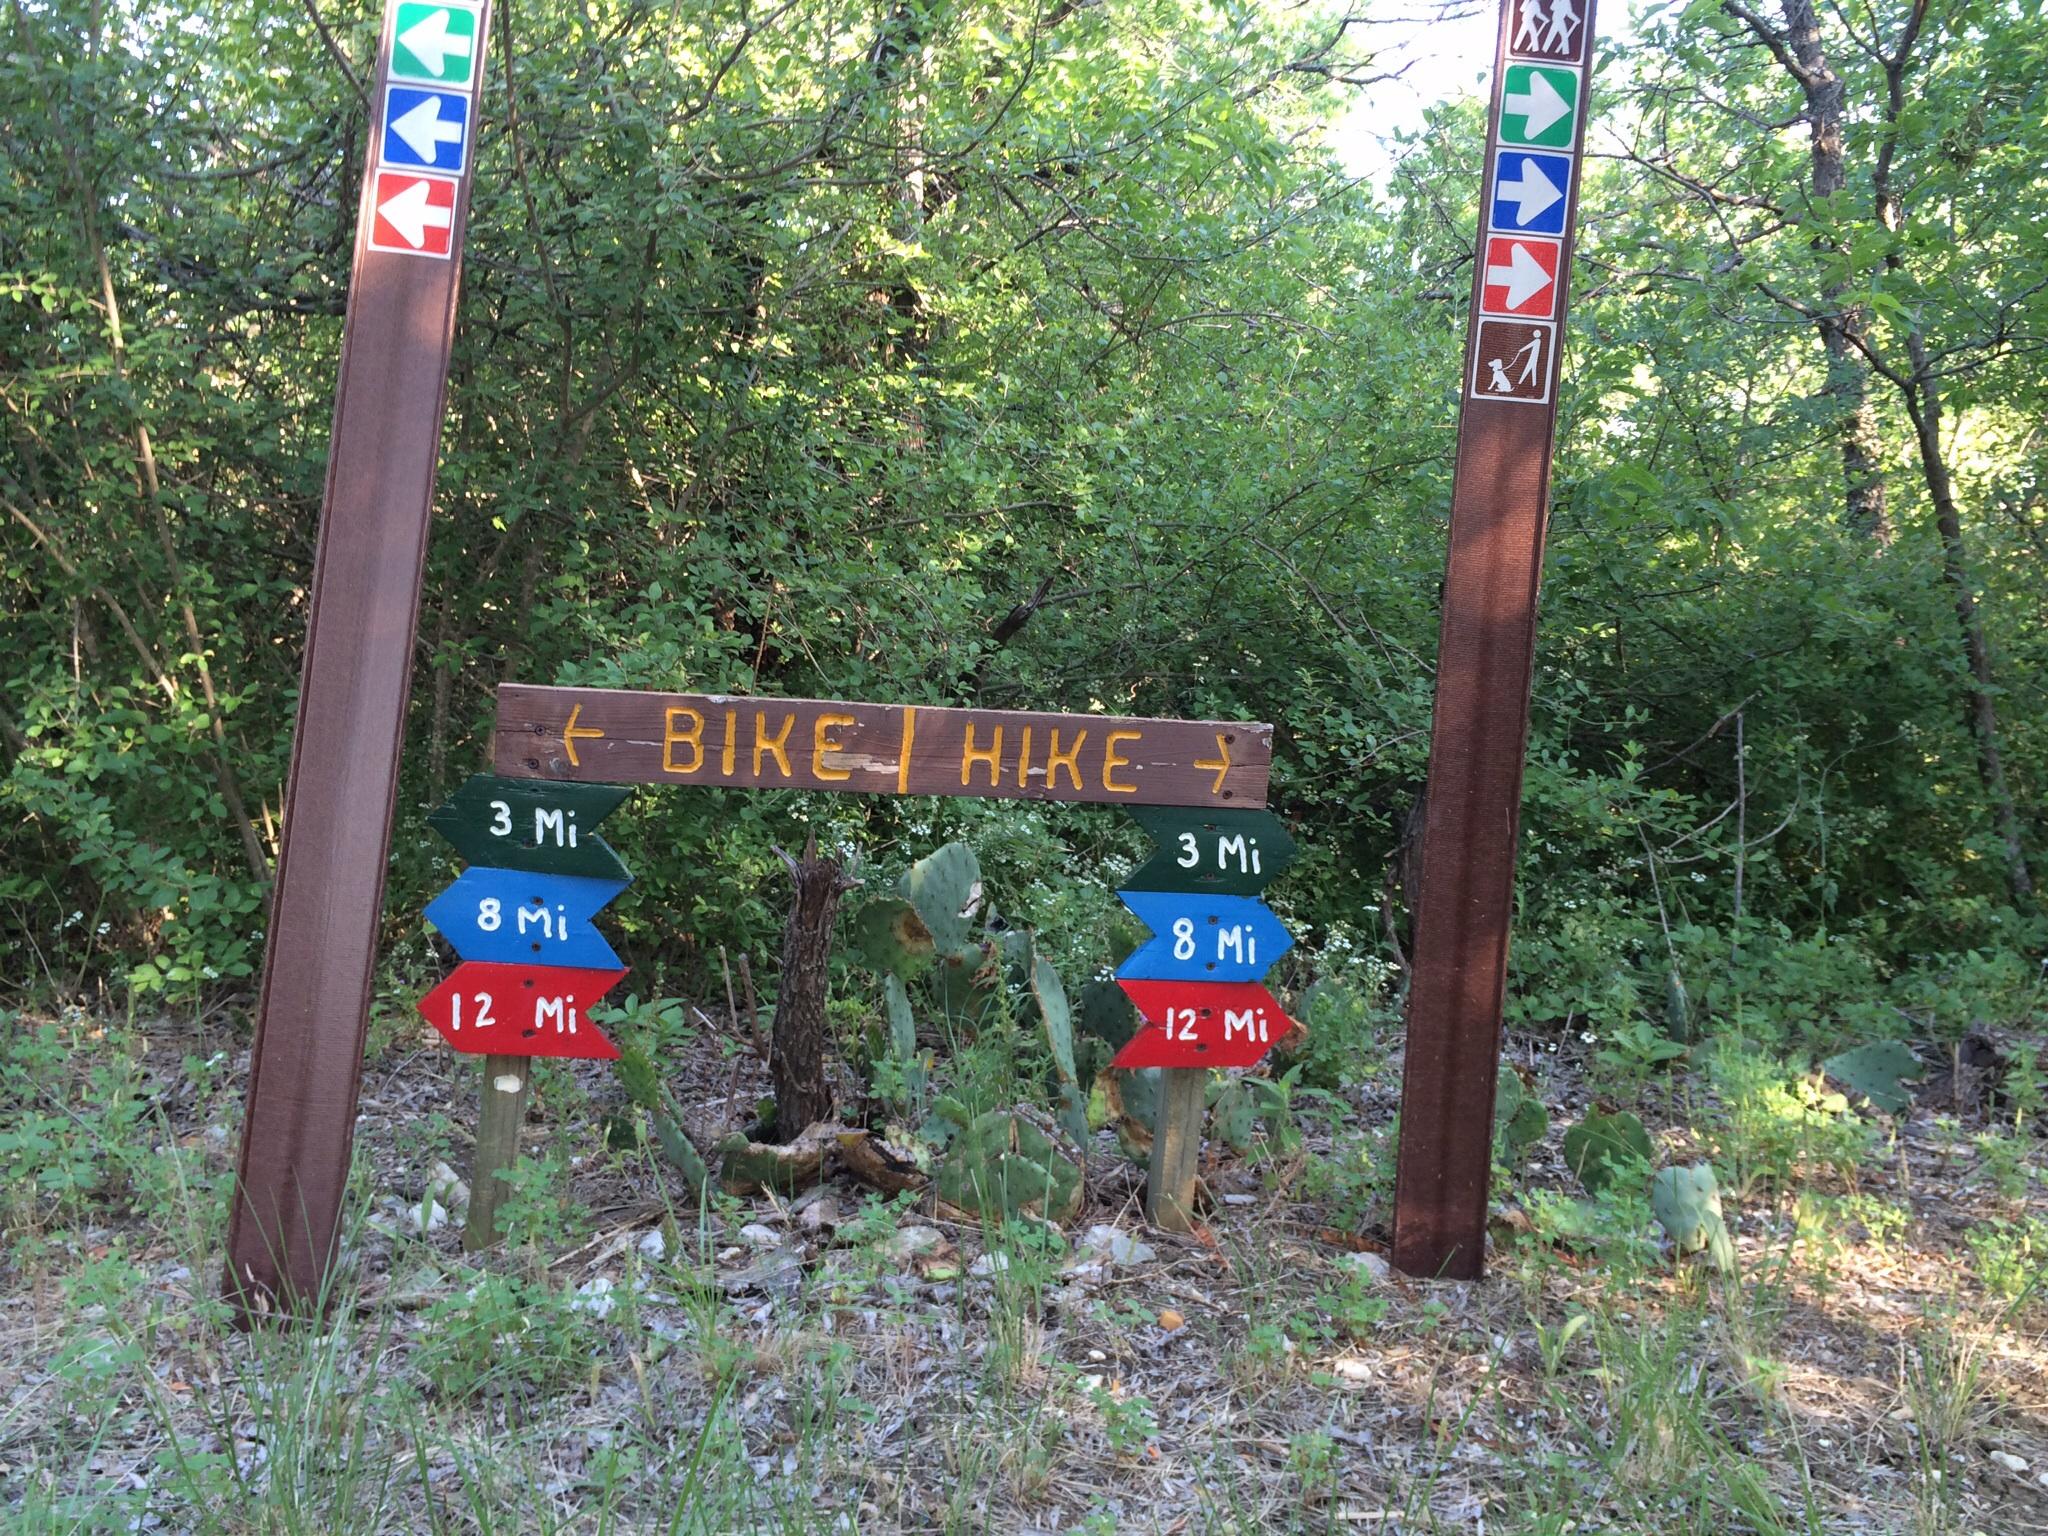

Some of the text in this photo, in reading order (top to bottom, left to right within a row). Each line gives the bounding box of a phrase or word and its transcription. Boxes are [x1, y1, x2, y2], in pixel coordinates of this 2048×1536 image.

[662, 706, 1143, 793] BIKE HIKE
[489, 800, 577, 848] 3 Mi
[1177, 832, 1261, 874] 3 Mi
[477, 898, 568, 941] 8 Mi
[1172, 917, 1256, 965] 8 Mi
[452, 991, 577, 1034] 12 Mi
[1166, 1007, 1269, 1042] 12 Mi
